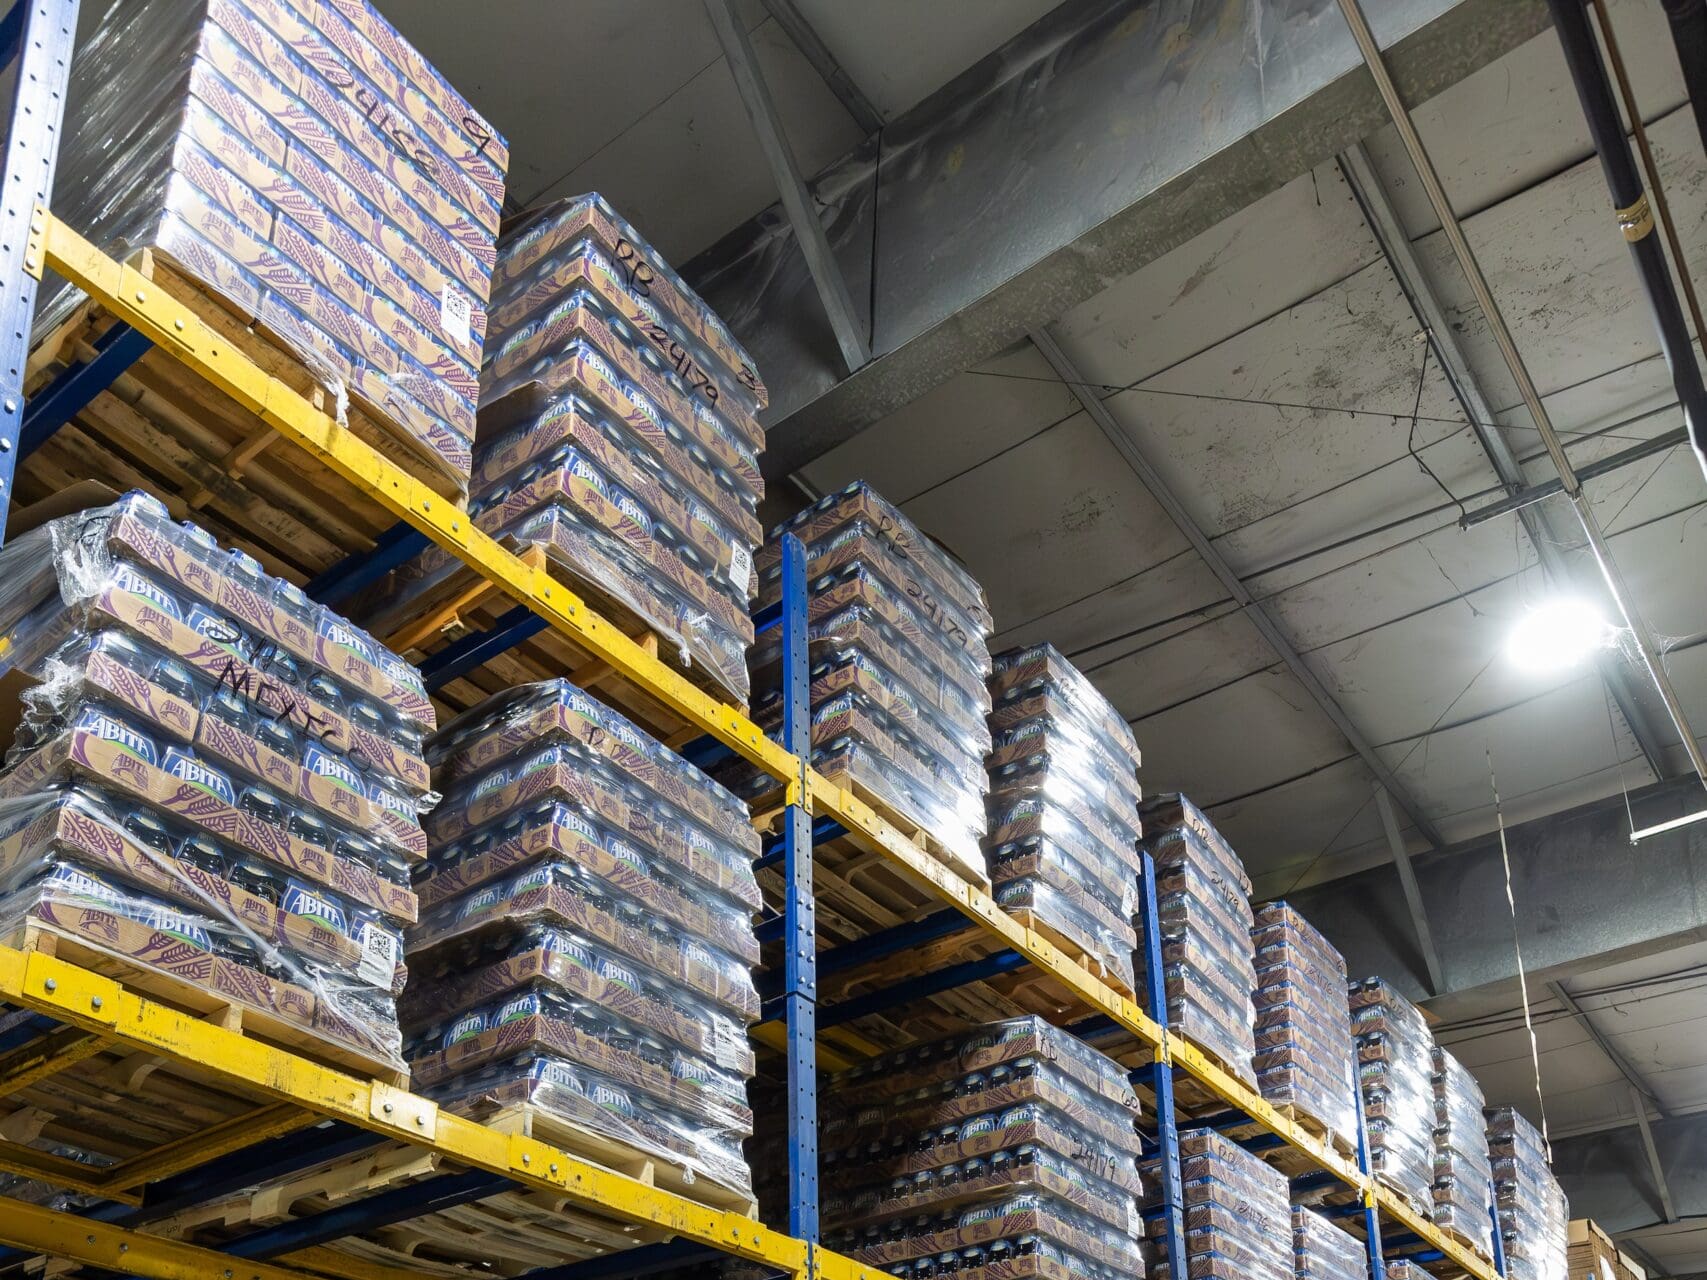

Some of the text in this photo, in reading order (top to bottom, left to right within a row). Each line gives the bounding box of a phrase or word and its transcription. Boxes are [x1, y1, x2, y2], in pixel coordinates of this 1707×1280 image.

[611, 238, 654, 298] RB
[584, 350, 618, 384] ABITA
[650, 325, 718, 411] 24179
[629, 391, 659, 421] ABITA
[700, 407, 726, 436] ABITA
[572, 459, 604, 494] ABITA
[618, 498, 649, 529] ABITA
[693, 505, 719, 534] ABITA
[184, 562, 213, 593] ABITA
[117, 572, 176, 619] ABITA
[136, 606, 173, 641] ABITA
[283, 620, 308, 649] ABITA
[327, 624, 376, 665] ABITA
[344, 654, 372, 687] ABITA
[384, 662, 423, 697] ABITA
[160, 700, 191, 731] ABITA
[213, 660, 372, 772] MEXICO
[568, 696, 602, 725] ABITA
[89, 719, 153, 763] ABITA
[616, 729, 650, 757] ABITA
[112, 753, 149, 792] ABITA
[171, 759, 229, 798] ABITA
[266, 756, 293, 785] ABITA
[312, 757, 363, 796] ABITA
[403, 758, 427, 783] ABITA
[521, 752, 553, 774] ABITA
[474, 772, 505, 797] ABITA
[330, 787, 360, 818] ABITA
[375, 791, 418, 826] ABITA
[562, 814, 599, 845] ABITA
[300, 847, 326, 876] ABITA
[612, 840, 647, 874] ABITA
[513, 871, 545, 897] ABITA
[241, 898, 268, 926] ABITA
[291, 893, 345, 934] ABITA
[389, 888, 413, 913] ABITA
[465, 892, 496, 917] ABITA
[80, 910, 118, 943] ABITA
[147, 910, 207, 948] ABITA
[309, 927, 338, 950] ABITA
[552, 937, 588, 962] ABITA
[602, 961, 635, 990] ABITA
[280, 989, 309, 1019] ABITA
[499, 999, 532, 1025] ABITA
[451, 1019, 482, 1046] ABITA
[543, 1066, 584, 1097] ABITA
[678, 1062, 711, 1084] ABITA
[594, 1086, 632, 1114] ABITA
[1071, 1140, 1117, 1182] 24179
